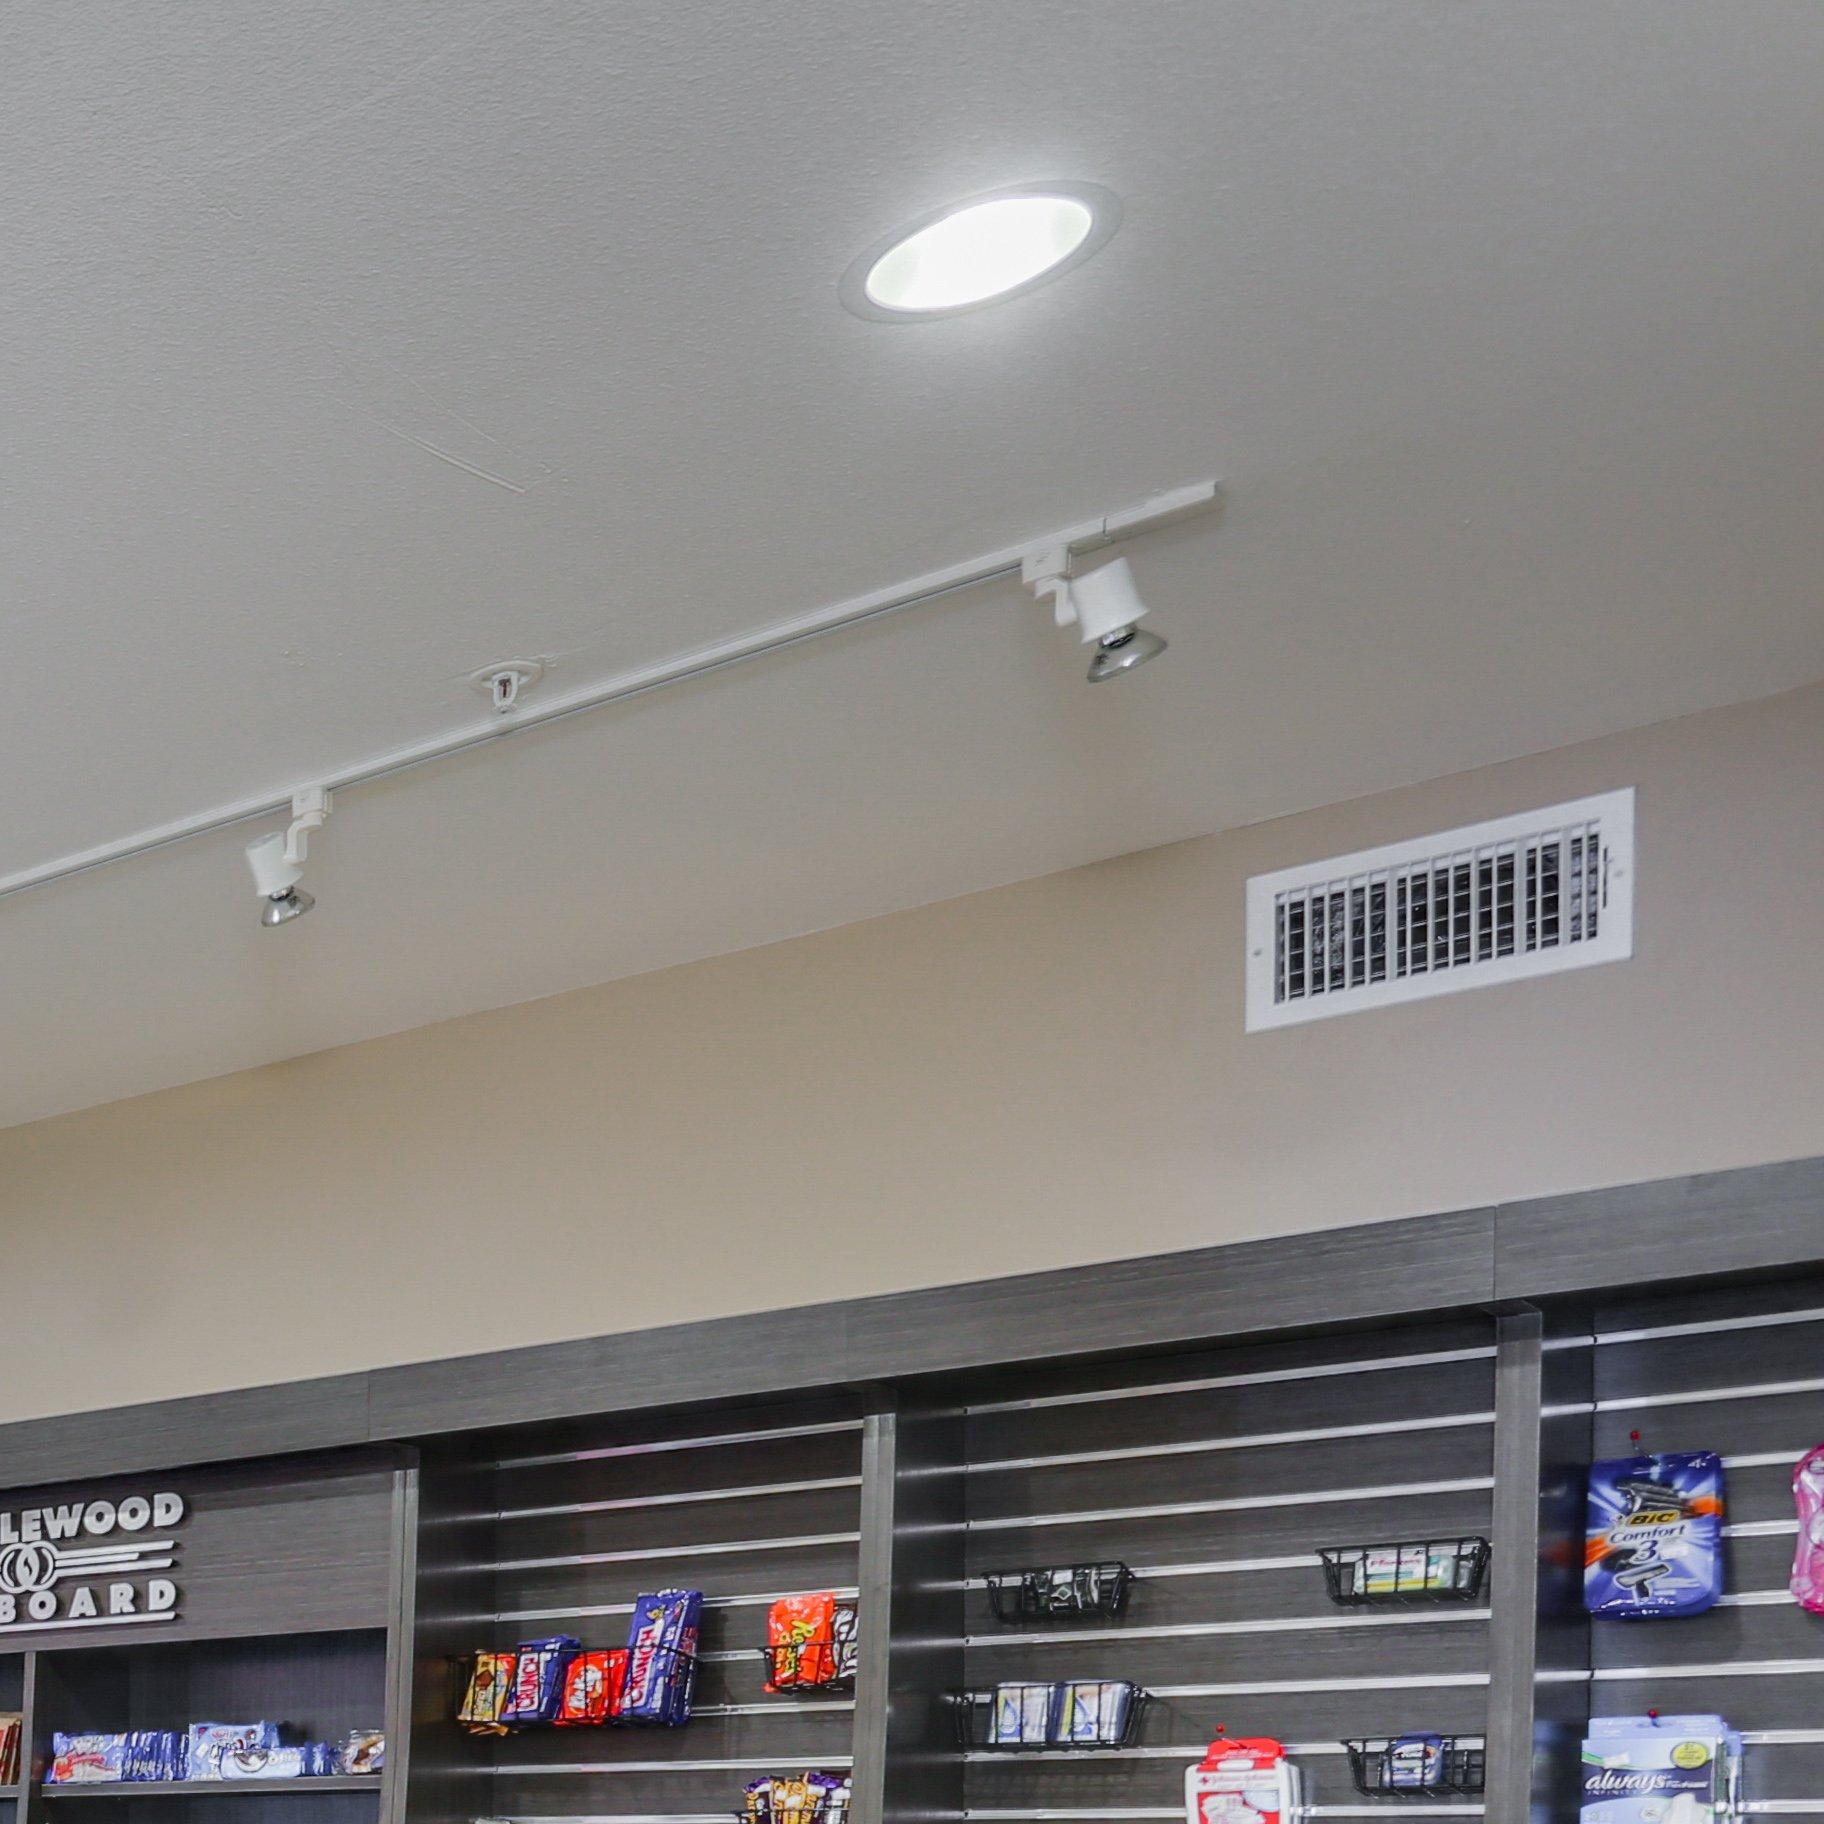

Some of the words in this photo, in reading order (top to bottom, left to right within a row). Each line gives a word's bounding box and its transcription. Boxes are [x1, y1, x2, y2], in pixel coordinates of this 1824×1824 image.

[1629, 1512, 1675, 1525] BIC
[1610, 1524, 1687, 1544] Comfort
[1632, 1540, 1658, 1562] 3
[1584, 1769, 1666, 1794] always
